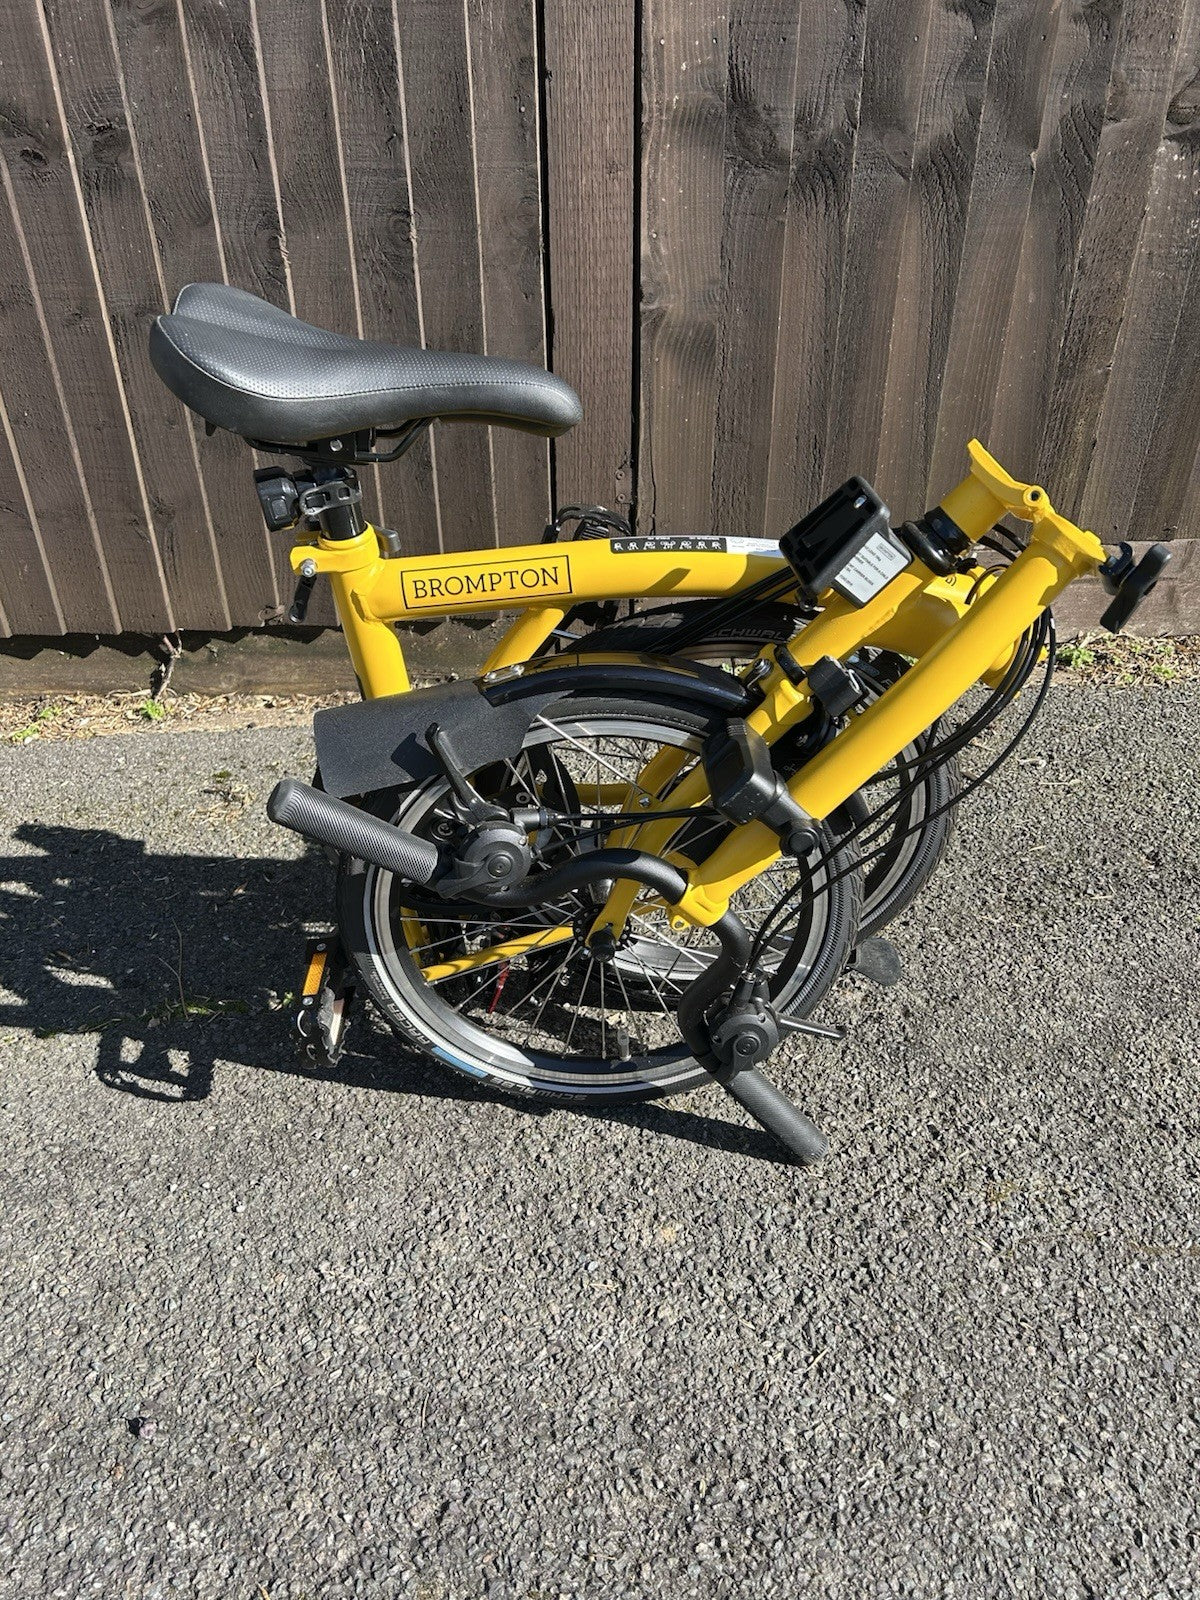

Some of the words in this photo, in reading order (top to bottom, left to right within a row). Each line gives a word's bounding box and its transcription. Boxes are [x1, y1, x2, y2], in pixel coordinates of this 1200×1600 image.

[412, 566, 559, 599] BROMPTON
[387, 1003, 431, 1045] RACER
[490, 1077, 587, 1101] SCHWALBE
